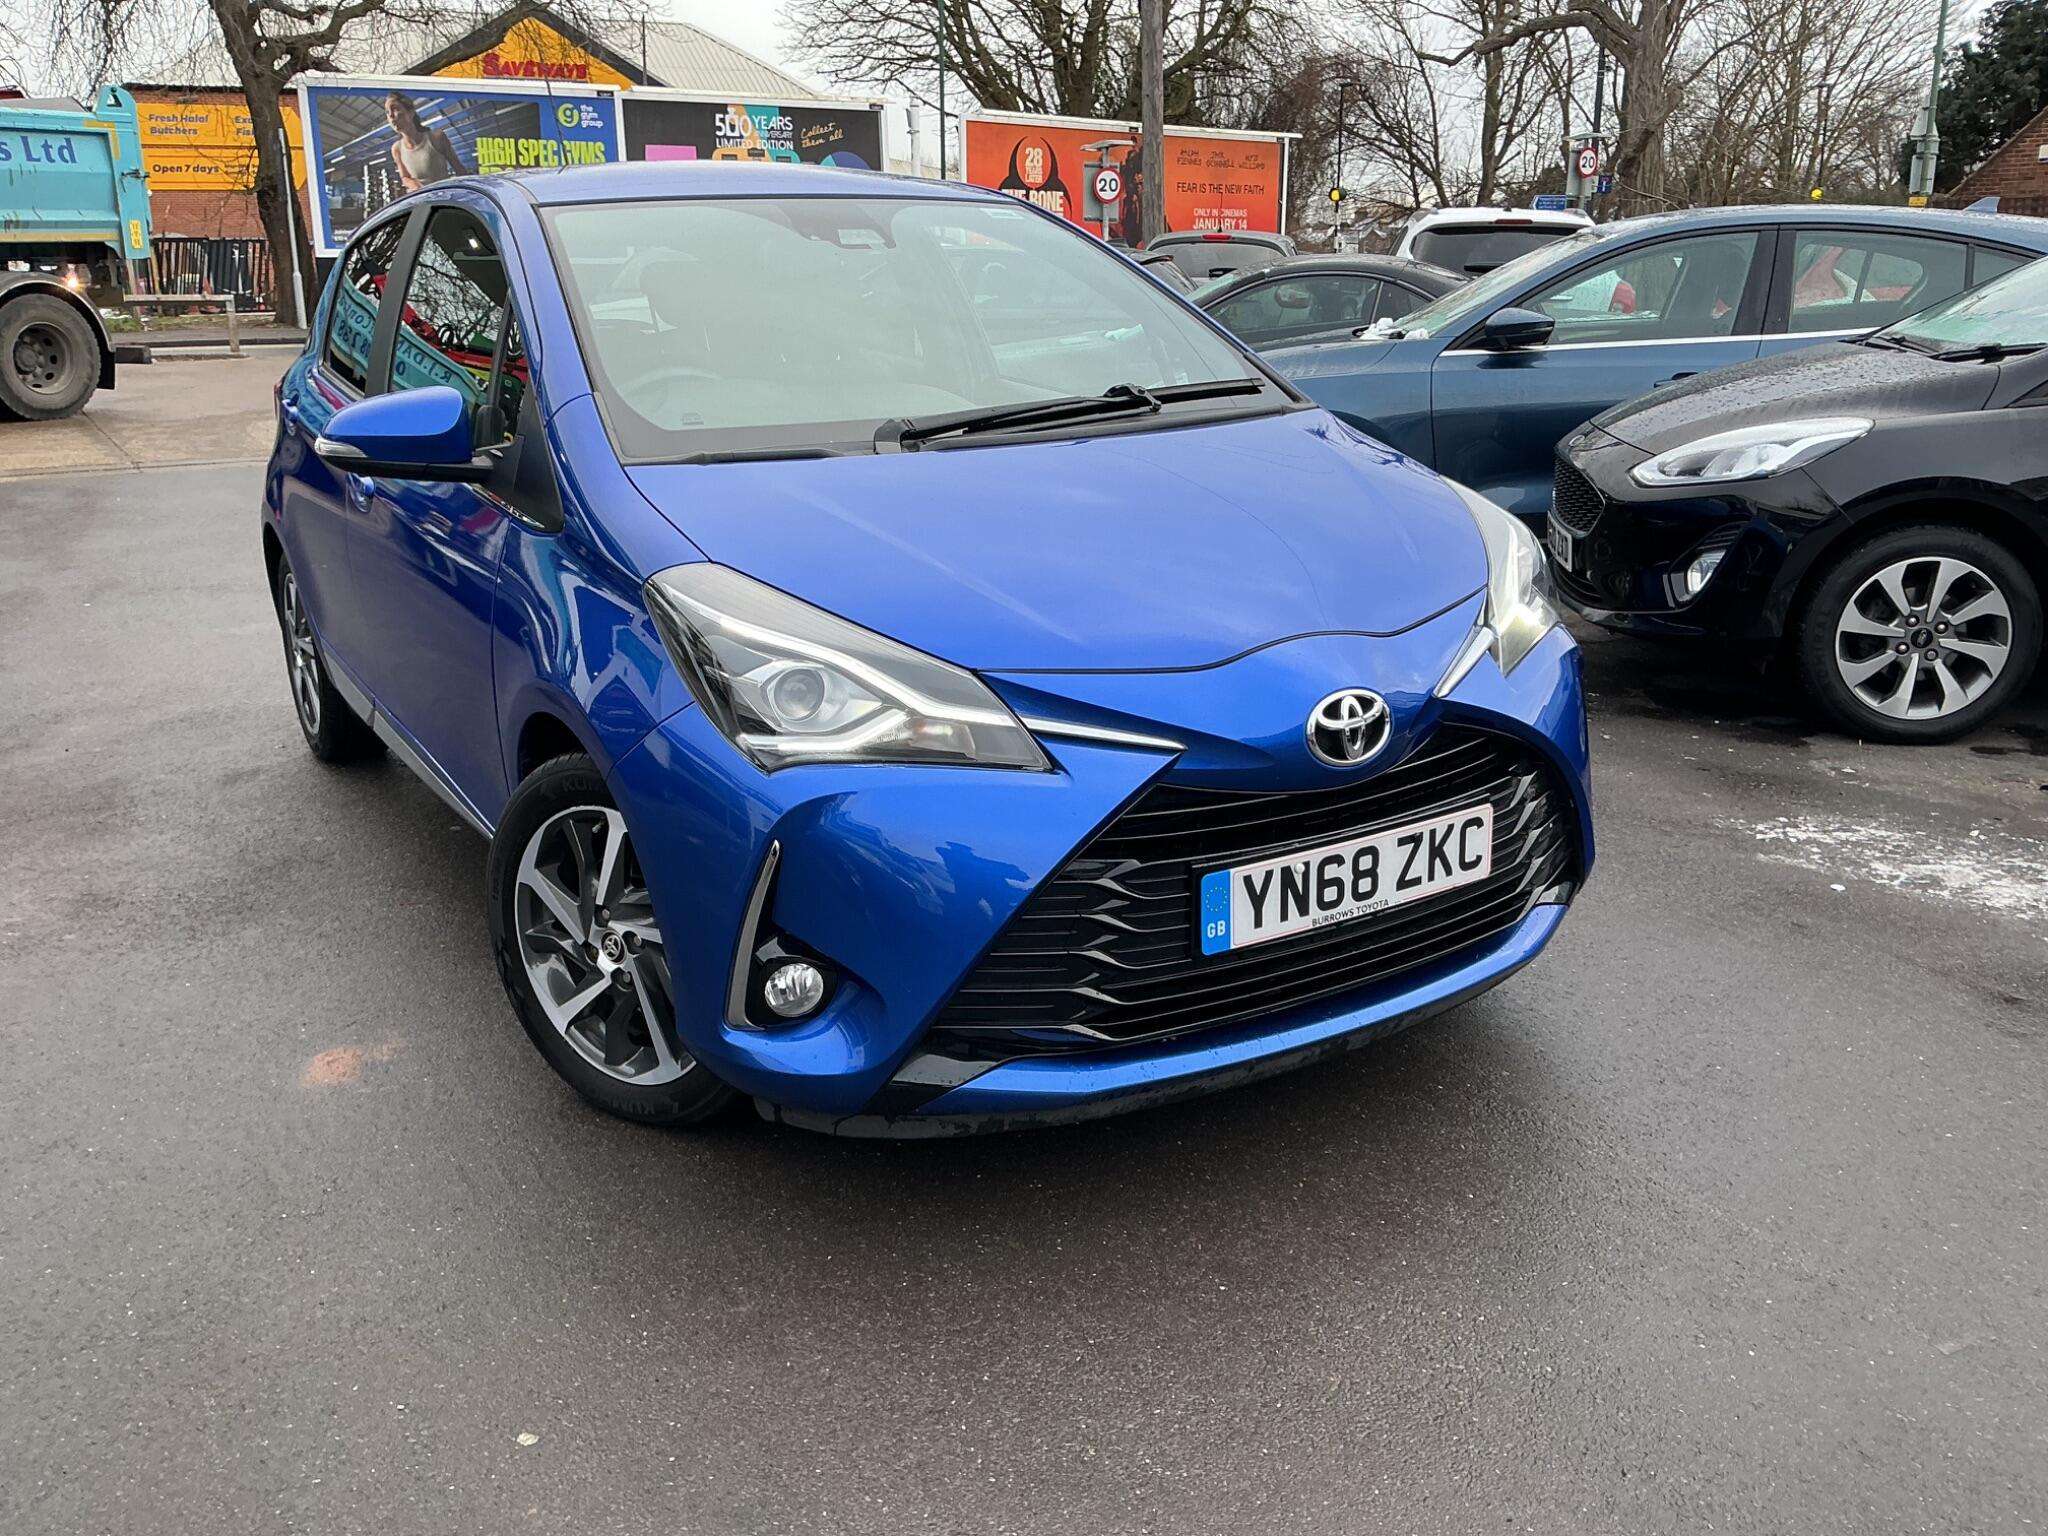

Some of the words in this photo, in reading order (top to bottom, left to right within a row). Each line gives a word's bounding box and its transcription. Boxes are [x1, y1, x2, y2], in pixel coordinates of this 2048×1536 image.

[149, 114, 178, 122] Fresh
[182, 114, 209, 123] Halal
[581, 120, 604, 129] group
[752, 115, 794, 130] YEARS
[150, 126, 198, 136] Butchers
[236, 128, 254, 136] Fis
[800, 122, 836, 139] Collect
[20, 135, 78, 164] Ltd
[716, 138, 753, 149] LIMITED
[756, 140, 794, 150] EDITION
[476, 137, 516, 166] HIGH
[518, 138, 559, 168] SPEC
[562, 140, 606, 166] GYMS
[1025, 147, 1043, 166] 28
[1581, 156, 1594, 168] 20
[152, 164, 183, 174] Open
[184, 164, 190, 173] 7
[192, 164, 220, 174] days
[1098, 178, 1119, 192] 20
[1176, 182, 1198, 193] FEAR
[1199, 183, 1207, 194] IS
[1208, 184, 1224, 194] THE
[1224, 184, 1242, 194] NEW
[1243, 184, 1265, 195] FAITH
[1029, 190, 1064, 212] BONE
[1193, 208, 1210, 216] ONLY
[1211, 208, 1218, 216] IN
[1220, 208, 1248, 217] CINEMAS
[1192, 218, 1236, 230] JANUARY
[1238, 219, 1248, 230] 14
[1242, 845, 1380, 930] YN68
[1395, 816, 1485, 892] ZKC
[1312, 908, 1354, 927] BURROWS
[1356, 899, 1390, 914] TOYOTA
[1207, 920, 1226, 938] GB
